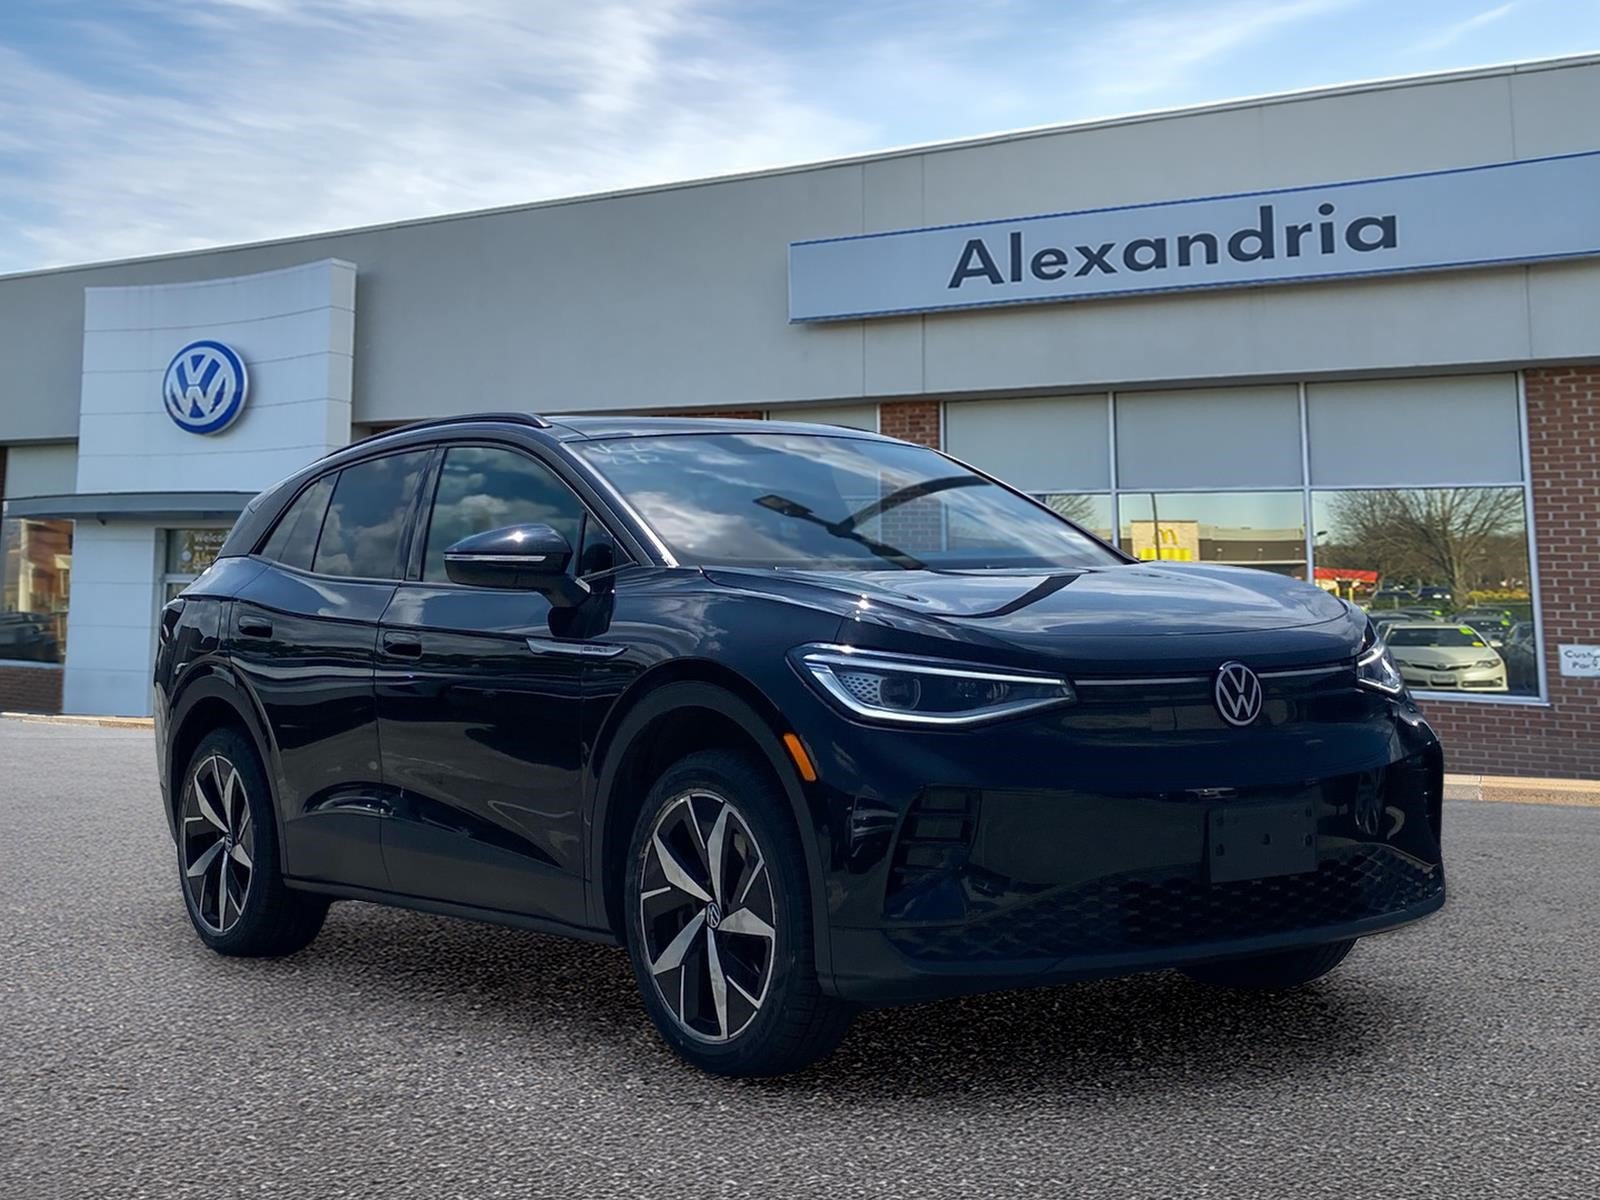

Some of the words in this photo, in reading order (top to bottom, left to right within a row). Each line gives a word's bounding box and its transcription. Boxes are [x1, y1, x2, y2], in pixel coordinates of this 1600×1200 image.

[948, 203, 1397, 288] Alexandria
[163, 340, 247, 433] VW
[1215, 663, 1262, 726] VW
